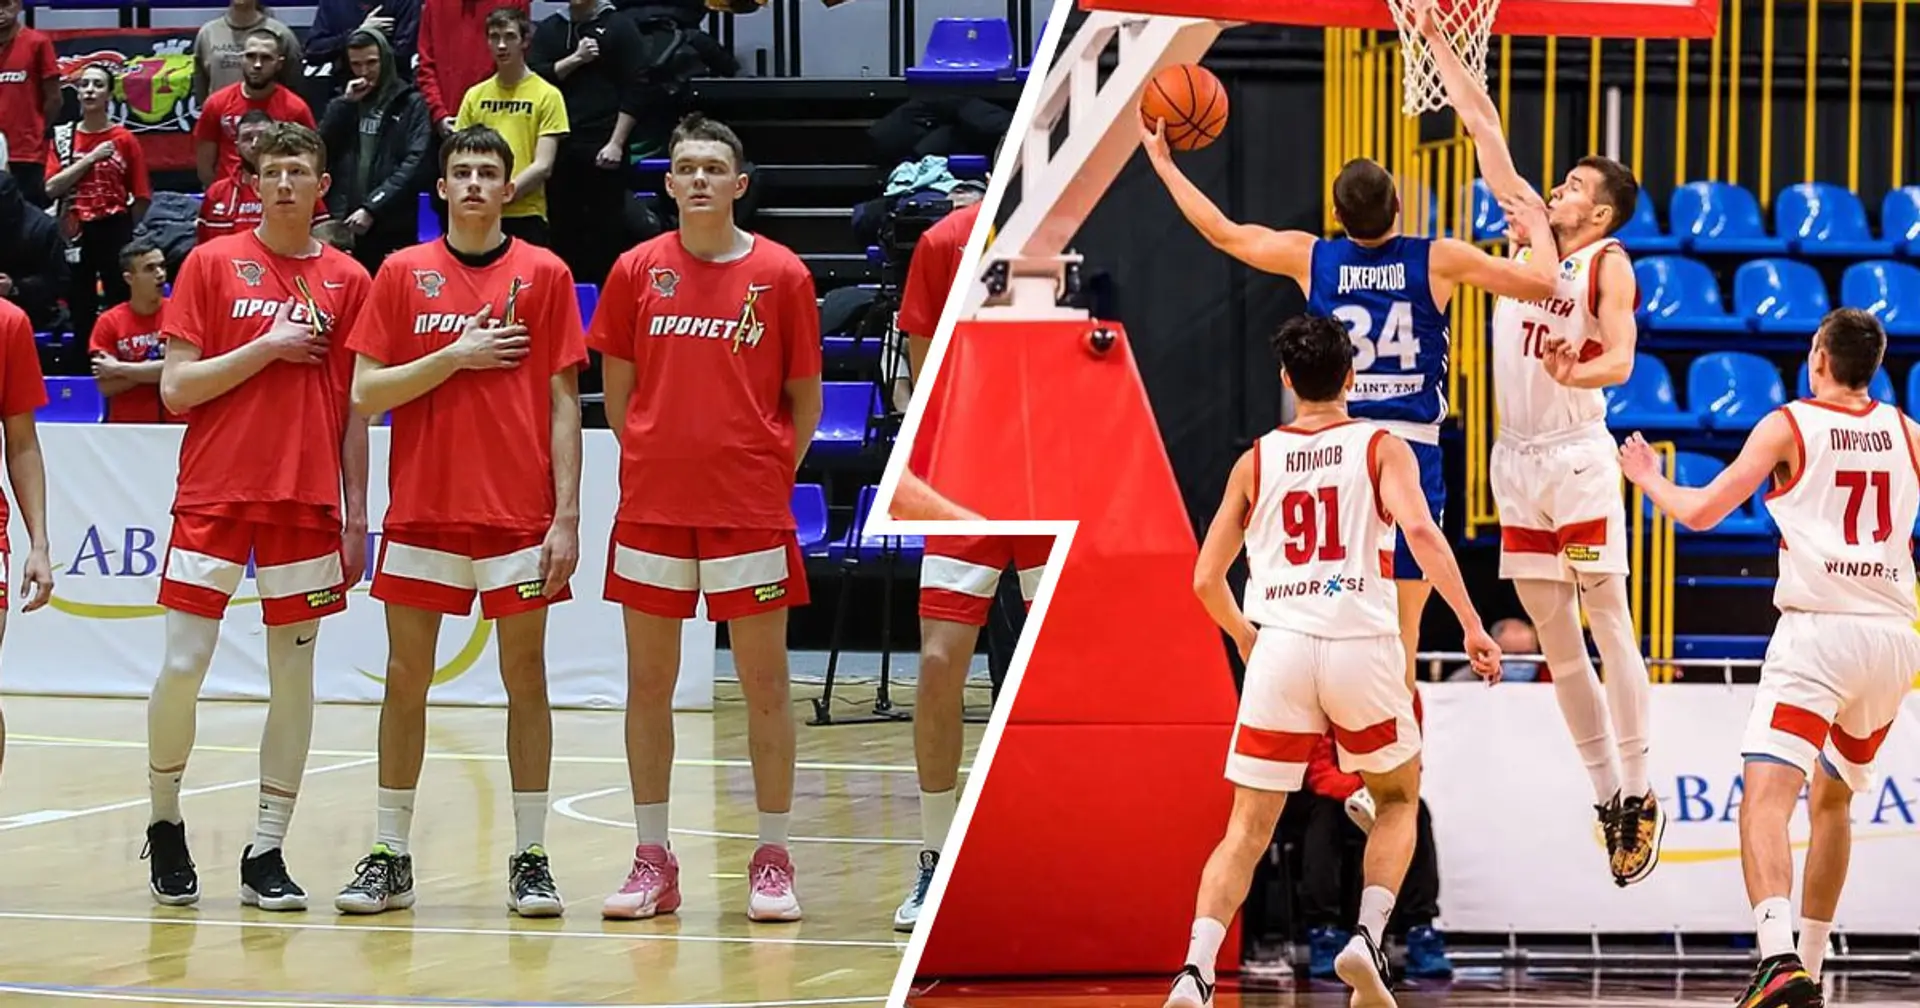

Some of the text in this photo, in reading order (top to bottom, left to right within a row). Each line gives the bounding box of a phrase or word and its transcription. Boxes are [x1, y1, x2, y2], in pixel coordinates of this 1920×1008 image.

[1338, 263, 1406, 294] ДЖЕРІХОВ
[1332, 301, 1421, 372] 34
[1354, 382, 1417, 394] LINT.TM
[1830, 428, 1893, 453] ПИРОГОВ
[1286, 445, 1343, 472] КЛІМОВ
[1835, 470, 1892, 545] 71
[1282, 486, 1346, 566] 91
